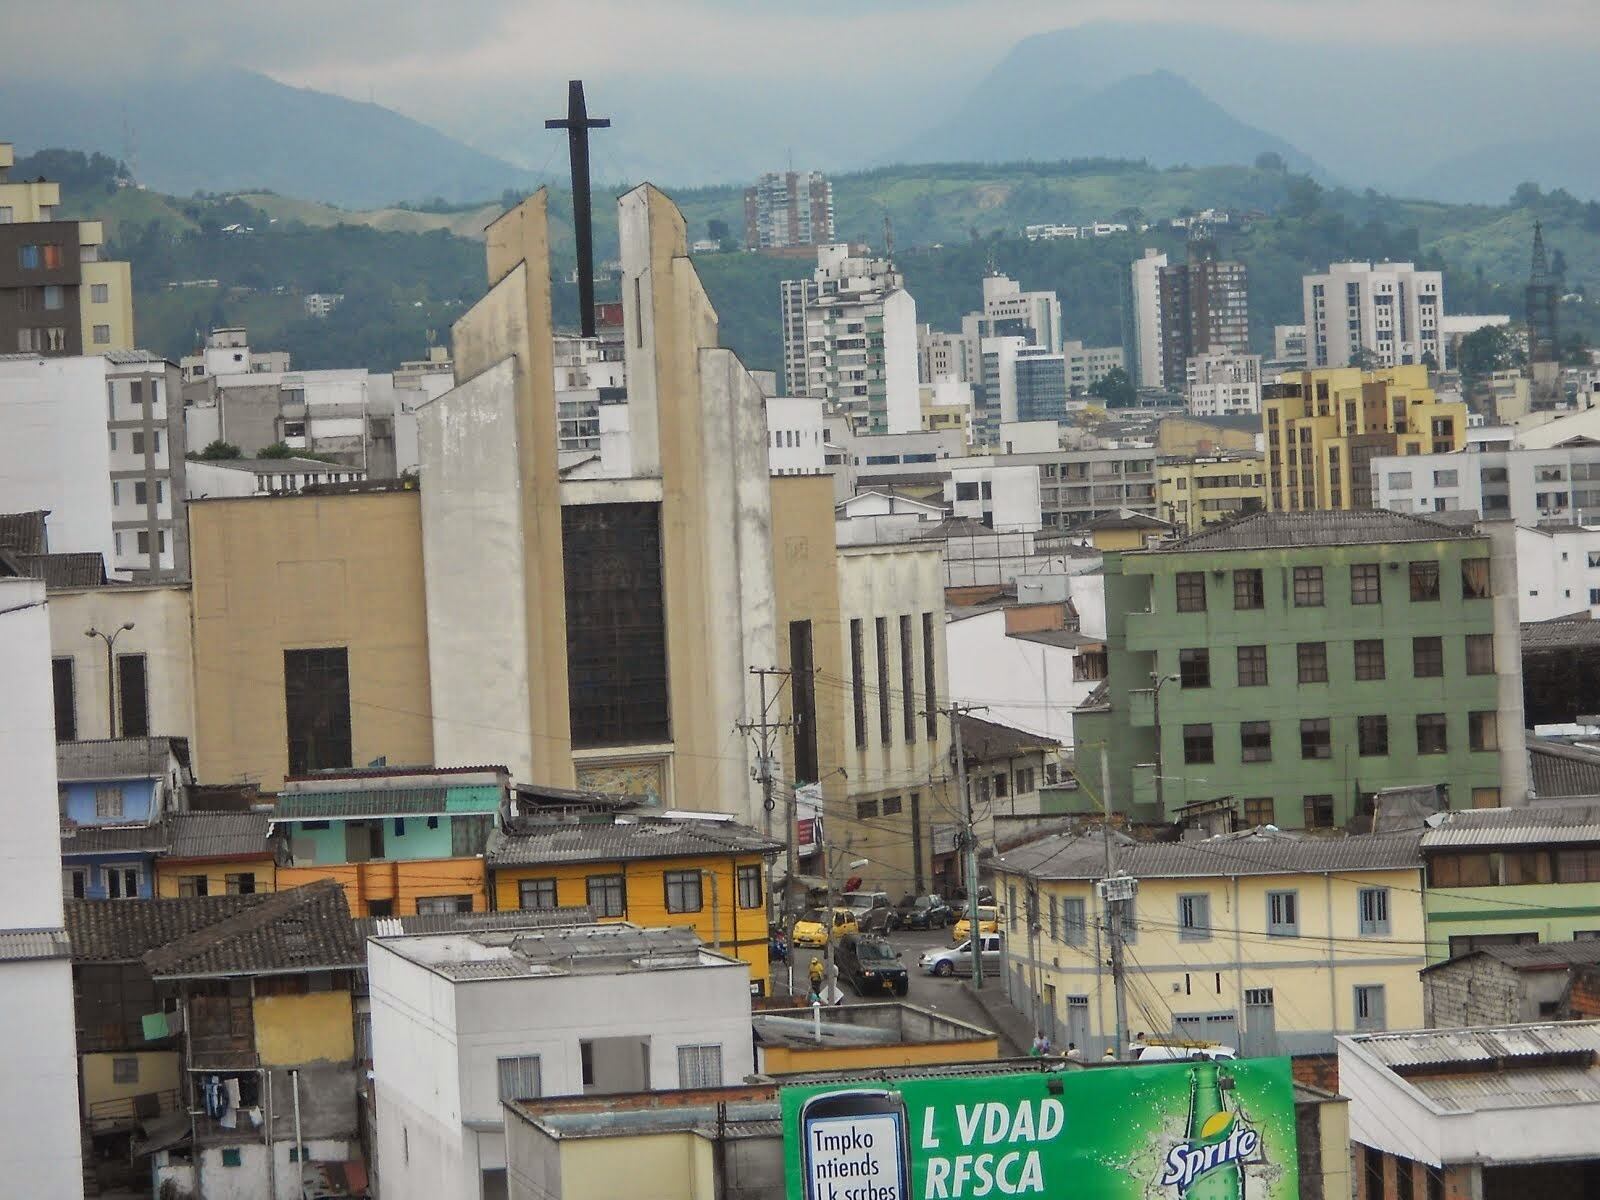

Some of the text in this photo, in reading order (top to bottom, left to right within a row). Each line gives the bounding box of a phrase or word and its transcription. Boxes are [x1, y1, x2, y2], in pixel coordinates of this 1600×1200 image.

[813, 1125, 874, 1156] Tmpko
[922, 1098, 1065, 1149] L VDAD
[816, 1152, 880, 1179] ntiends
[924, 1150, 1044, 1200] RFSCA
[1160, 1119, 1258, 1187] Sprite
